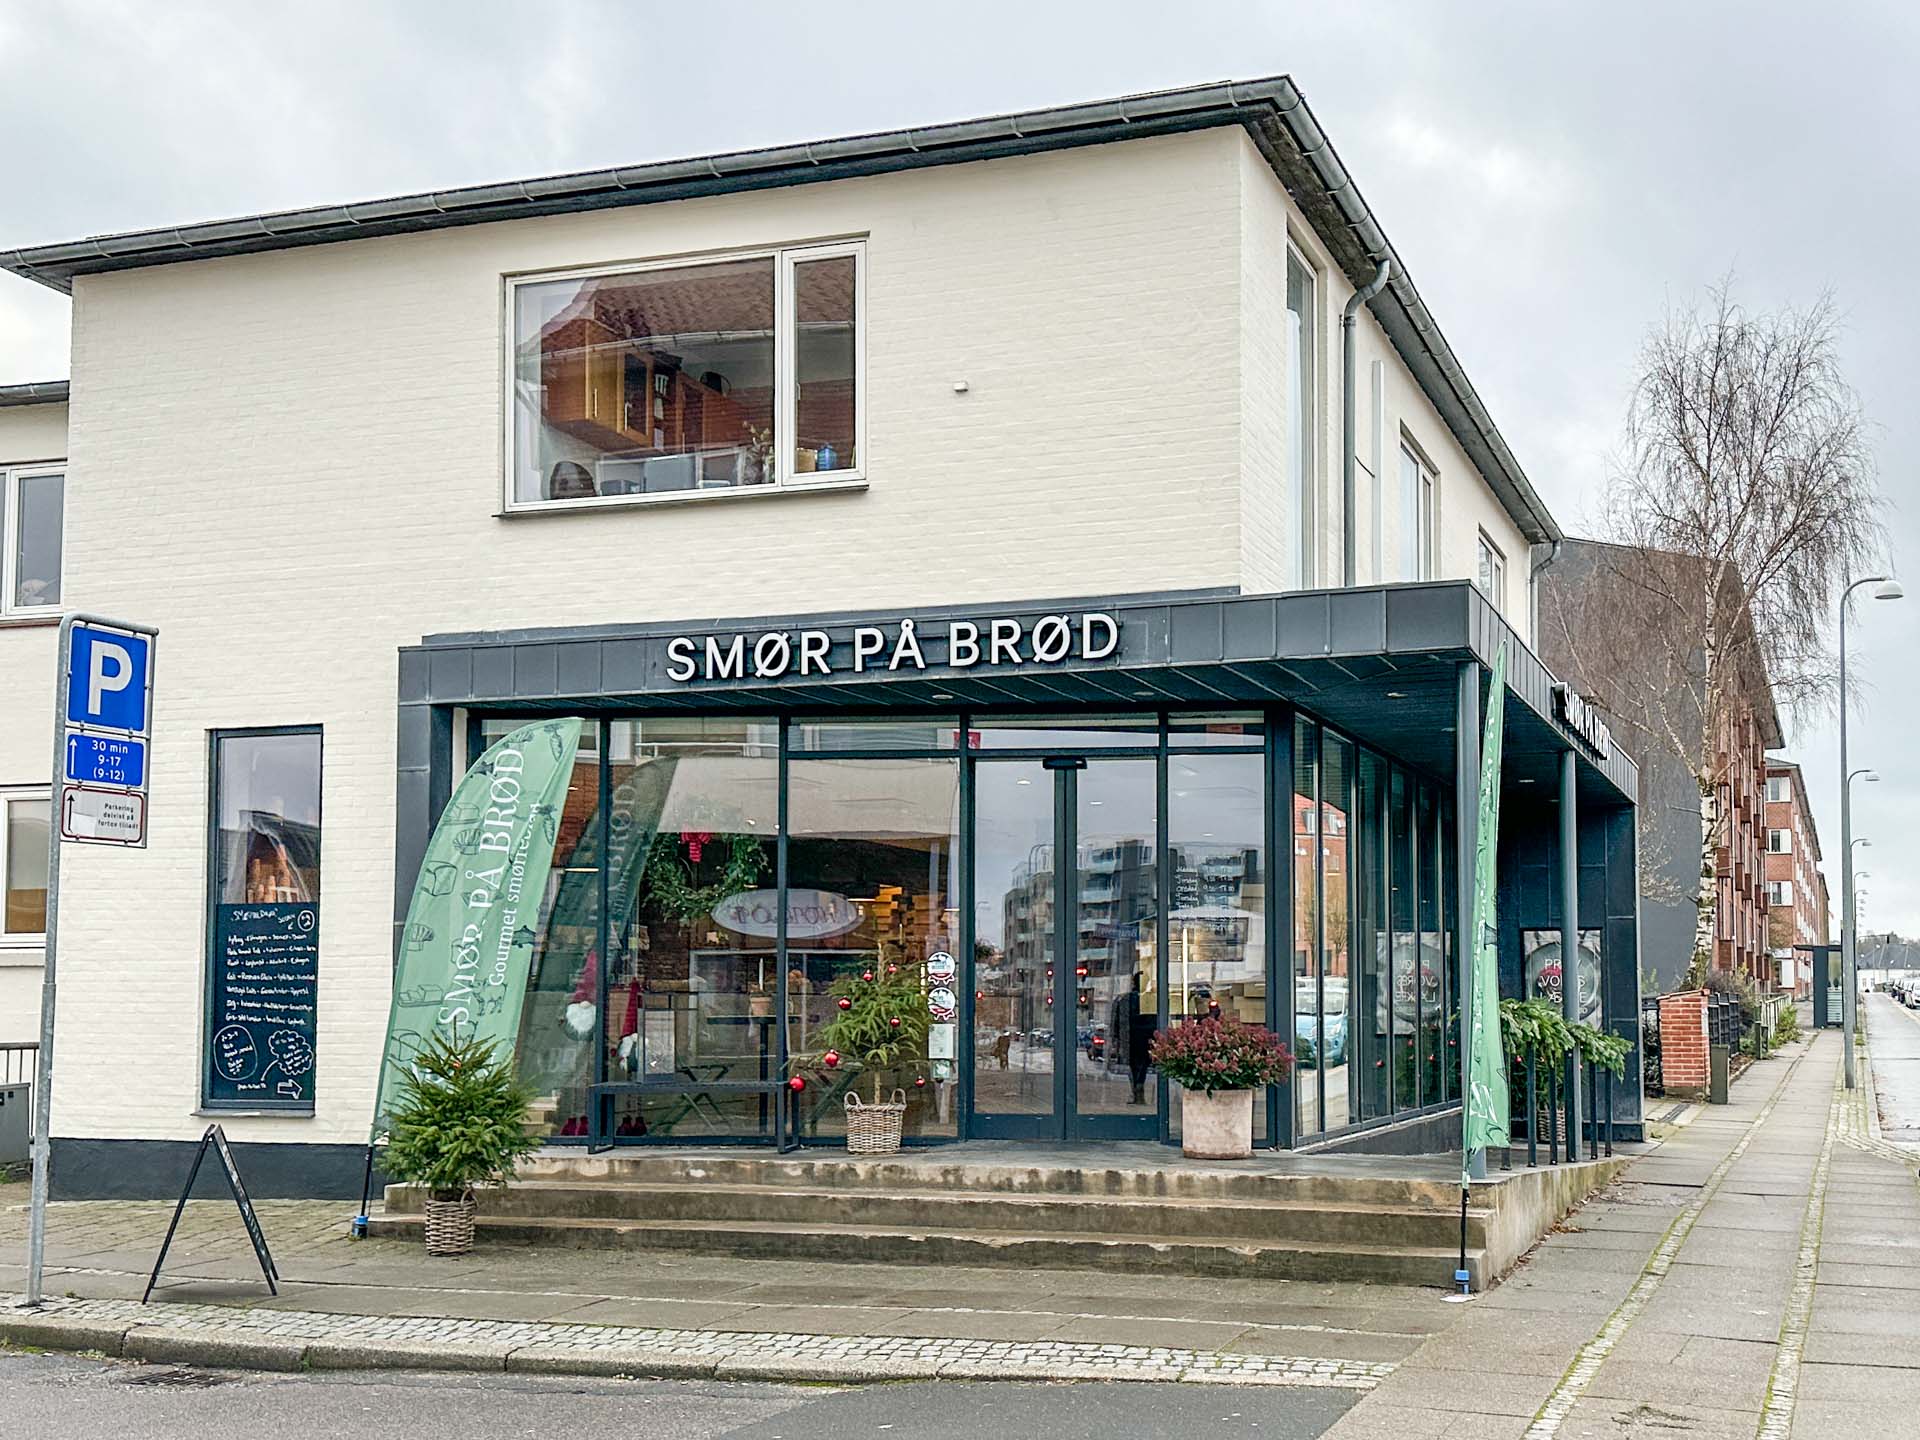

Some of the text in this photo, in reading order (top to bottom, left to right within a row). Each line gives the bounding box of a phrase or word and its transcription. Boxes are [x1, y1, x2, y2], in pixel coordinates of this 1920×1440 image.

[666, 613, 1118, 682] SMØR PÅ BRØD
[87, 639, 133, 716] P
[1564, 682, 1585, 736] SMØR
[92, 739, 128, 754] 30 min
[98, 754, 121, 767] 9-17
[93, 766, 125, 782] (9-12)
[104, 803, 134, 813] Parkering
[479, 748, 525, 854] BRØD
[464, 865, 505, 909] PÅ
[488, 907, 518, 986] Gourmet
[438, 919, 488, 1026] SMØR
[1540, 975, 1586, 987] VOS
